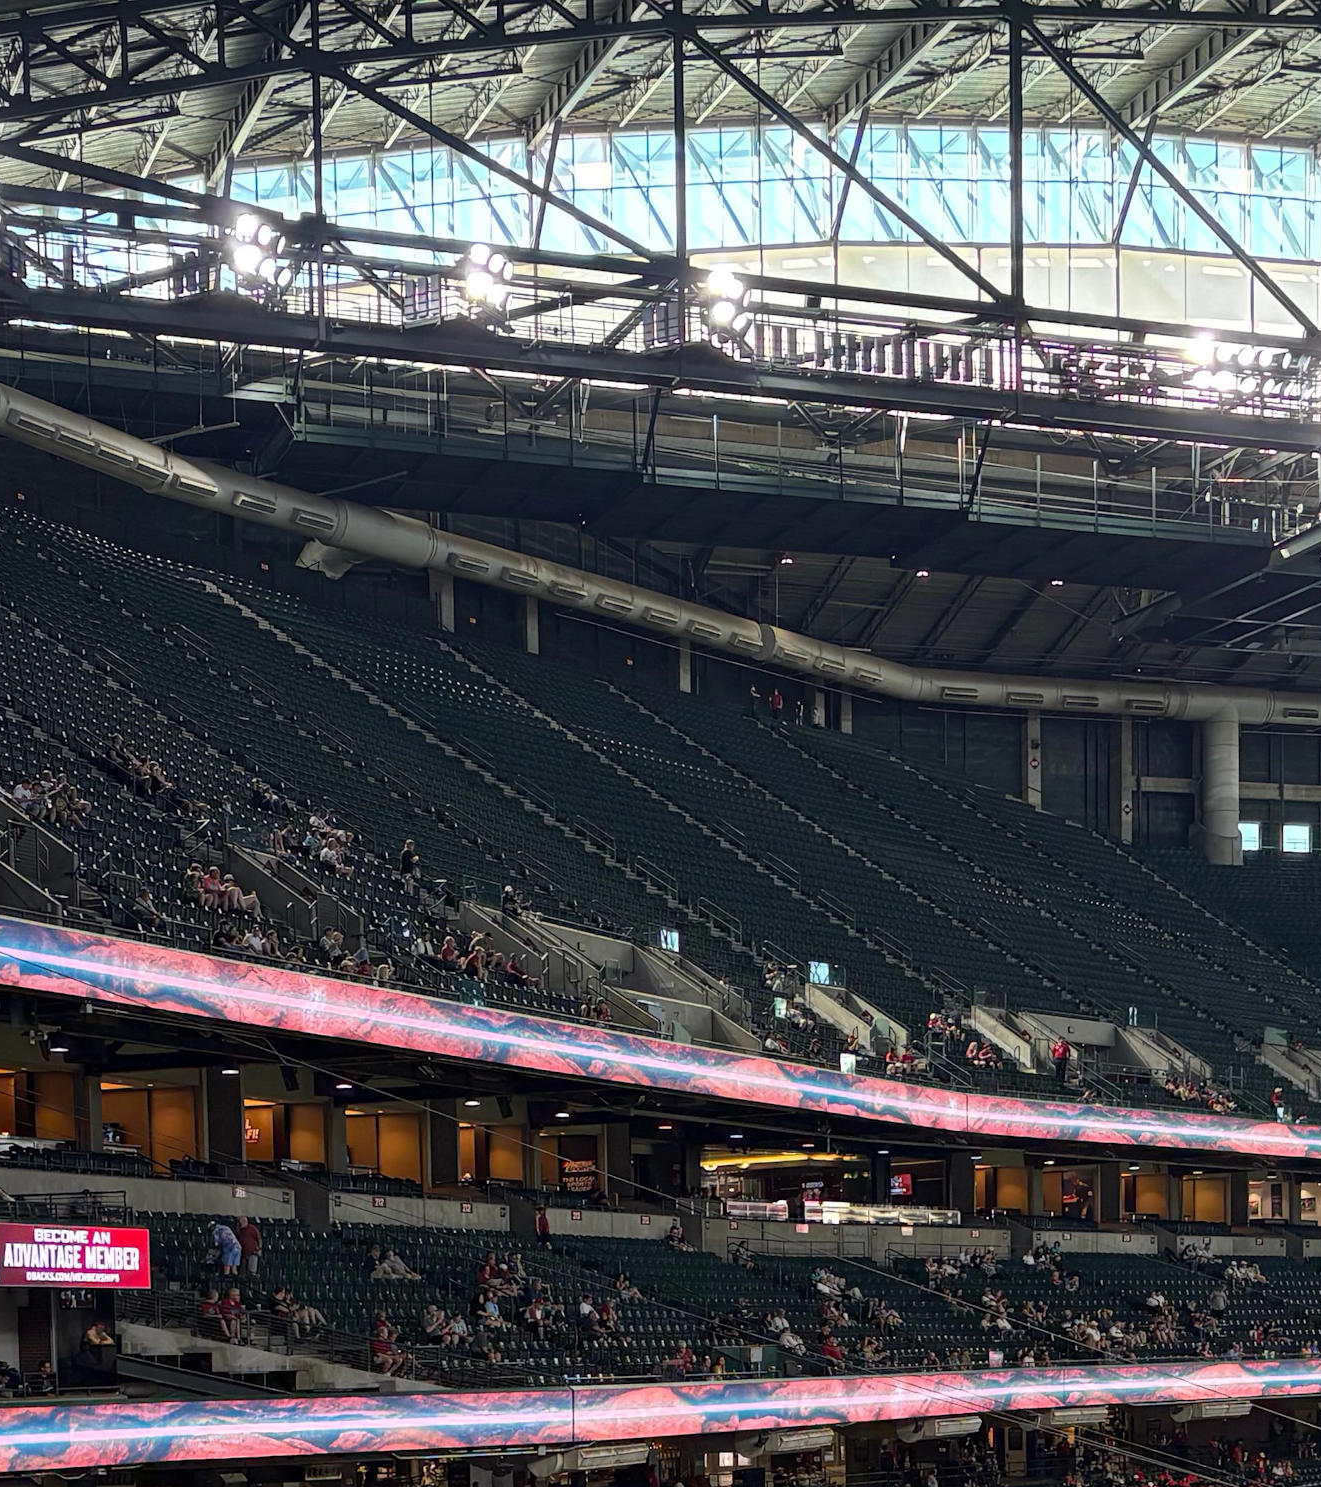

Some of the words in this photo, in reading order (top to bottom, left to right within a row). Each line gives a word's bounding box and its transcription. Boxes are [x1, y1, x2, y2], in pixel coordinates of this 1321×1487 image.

[34, 1228, 89, 1244] BECOME
[92, 1231, 111, 1245] AN
[4, 1242, 82, 1268] ADVANTAGE
[85, 1246, 140, 1271] MEMBER
